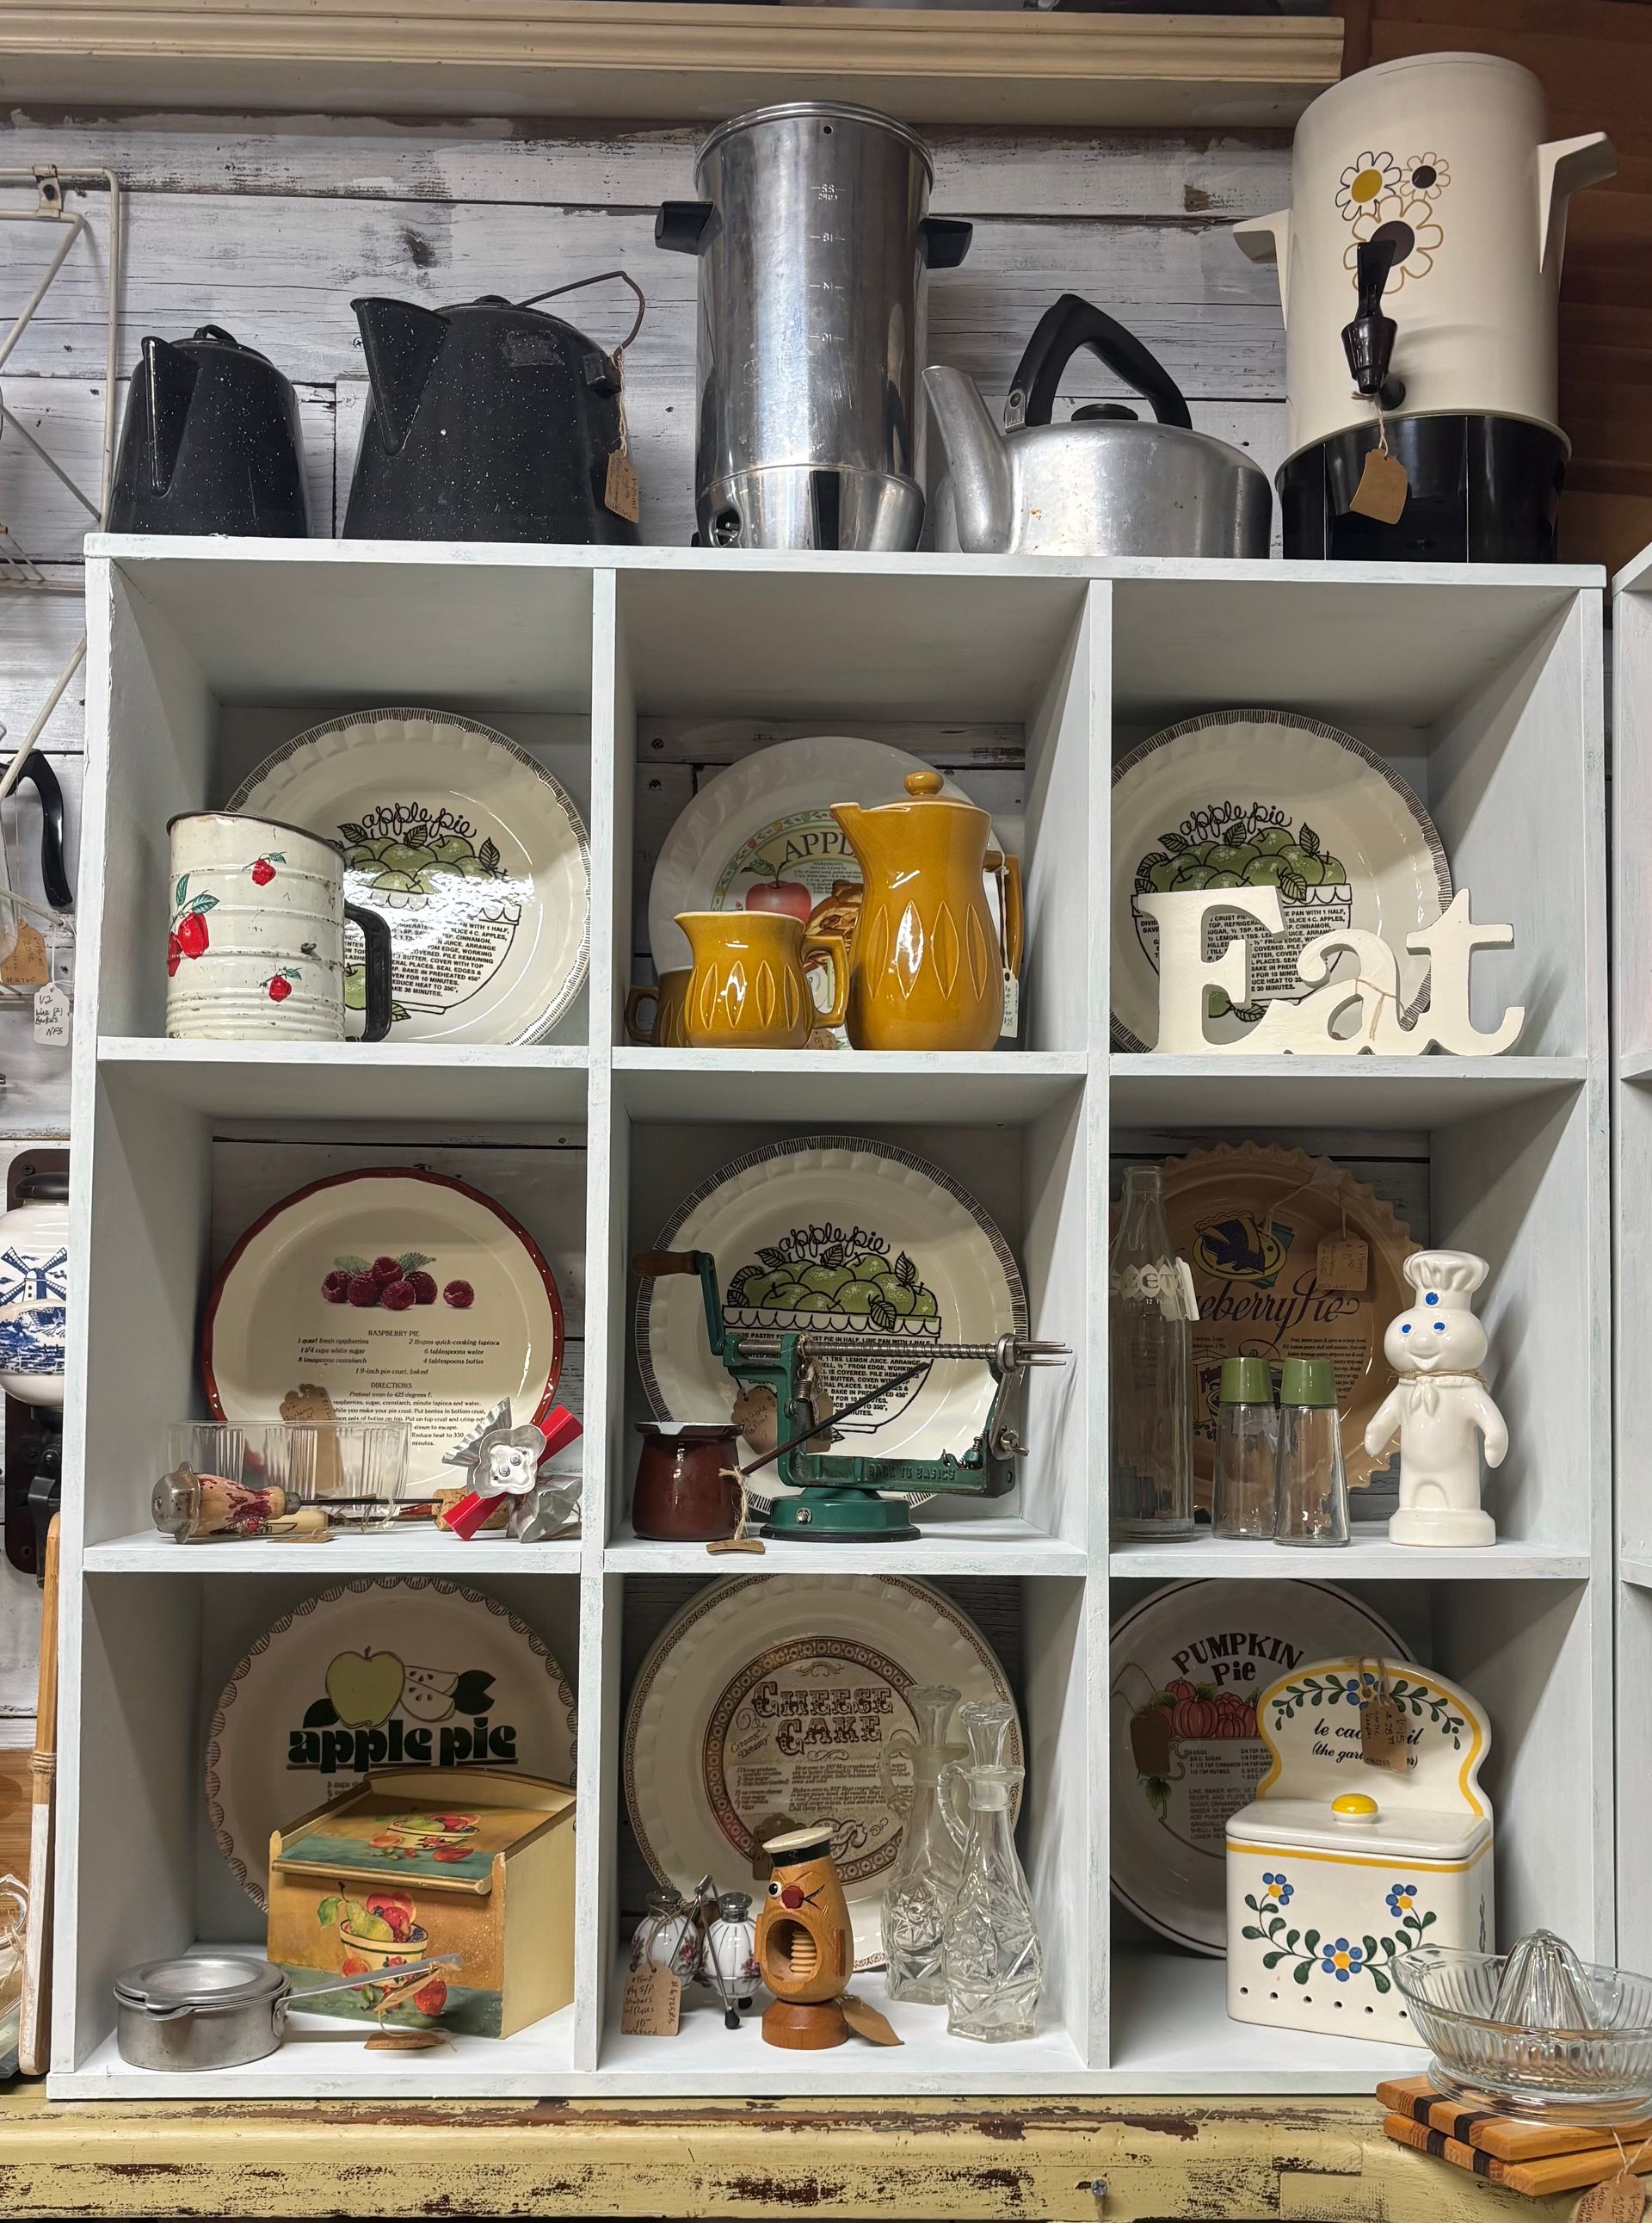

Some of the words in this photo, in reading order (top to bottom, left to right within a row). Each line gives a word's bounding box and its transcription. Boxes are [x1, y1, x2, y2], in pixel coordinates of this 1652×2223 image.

[362, 802, 431, 836] apple
[431, 807, 477, 838] pie
[1180, 800, 1248, 840] apple
[1247, 802, 1292, 833] pie
[785, 831, 854, 861] APPL
[456, 934, 491, 944] CINNAMON,
[465, 942, 496, 951] ARRANGE
[482, 932, 507, 941] APPLES,
[458, 954, 494, 964] REMAINING
[1137, 885, 1526, 1056] Eat
[428, 971, 465, 980] PREHEATED
[778, 1222, 846, 1258] apple
[845, 1226, 891, 1257] pie
[1170, 1633, 1304, 1676] PUMPKIN
[1211, 1658, 1257, 1686] Pie
[751, 1681, 894, 1719] CHEESE
[775, 1715, 883, 1756] CAKE
[1314, 1718, 1329, 1736] le
[288, 1720, 433, 1774] apple
[440, 1716, 517, 1767] pie
[1313, 1741, 1335, 1757] (the
[1335, 1751, 1363, 1763] gar
